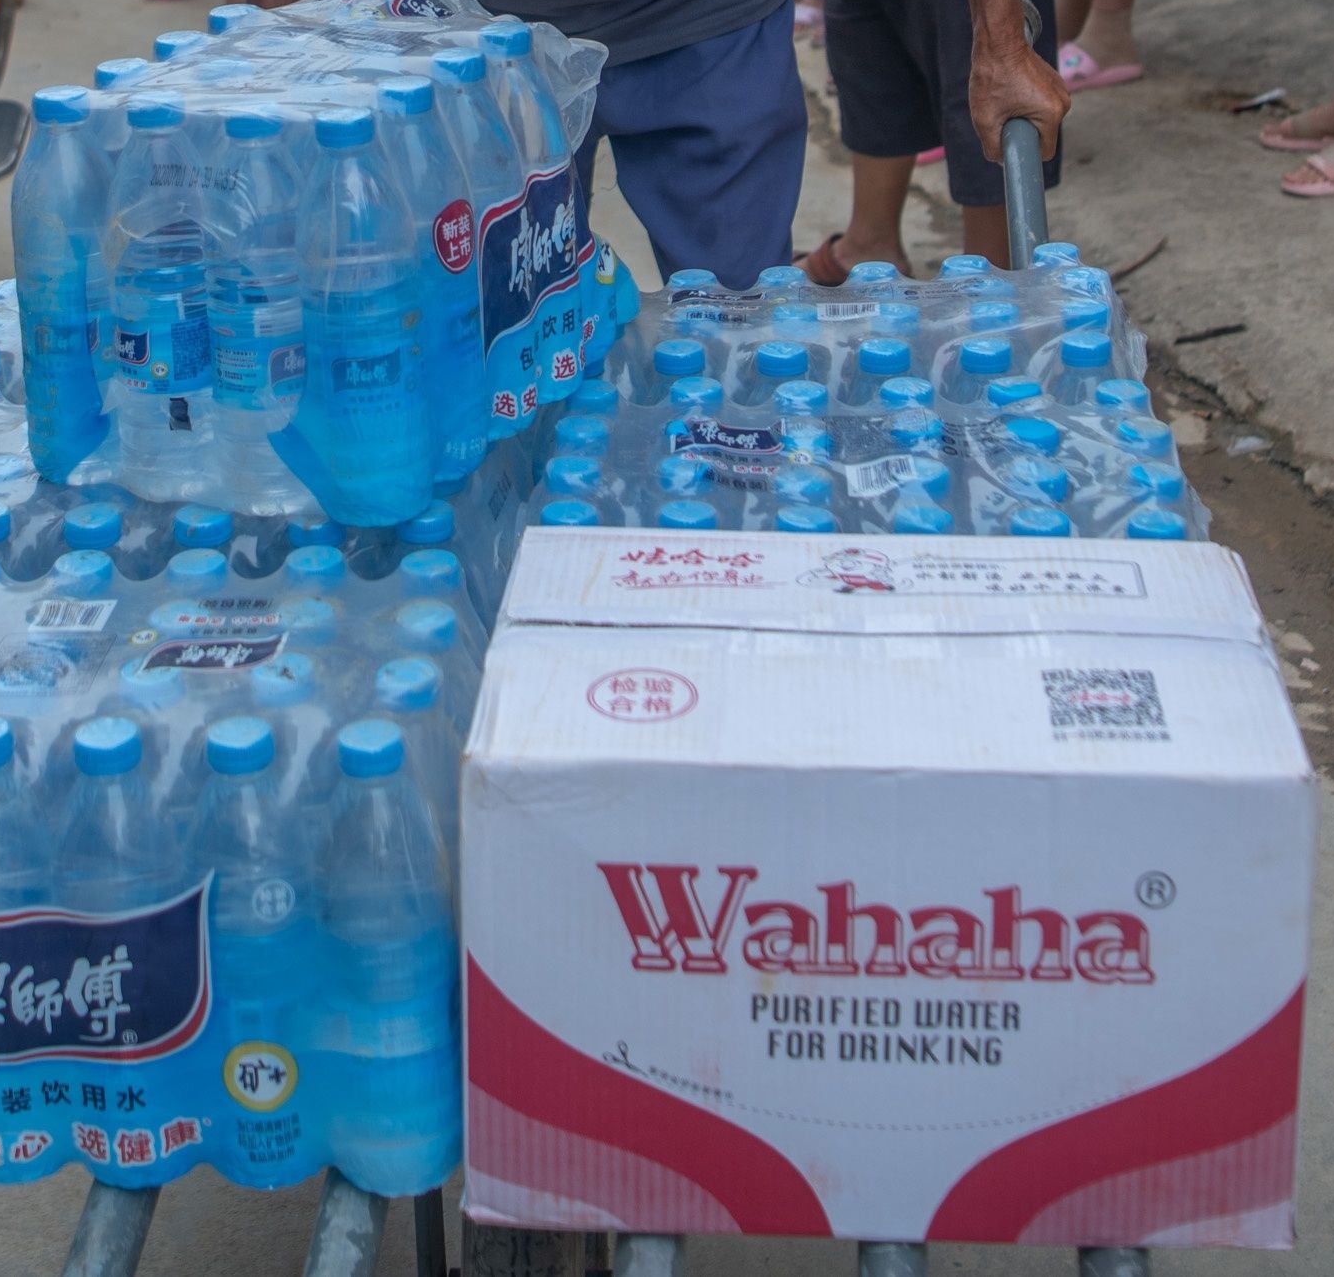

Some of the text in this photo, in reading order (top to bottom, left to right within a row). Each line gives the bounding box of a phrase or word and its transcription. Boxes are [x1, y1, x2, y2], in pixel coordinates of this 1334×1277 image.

[442, 213, 471, 241] 新装
[446, 237, 471, 263] 上市
[609, 677, 674, 694] 检验
[606, 695, 672, 713] 合格
[595, 860, 1157, 986] Wahaha
[750, 993, 1021, 1032] PURIFIED WATER
[768, 1029, 1003, 1066] FOR DRINKING
[72, 1119, 202, 1168] 选健康
